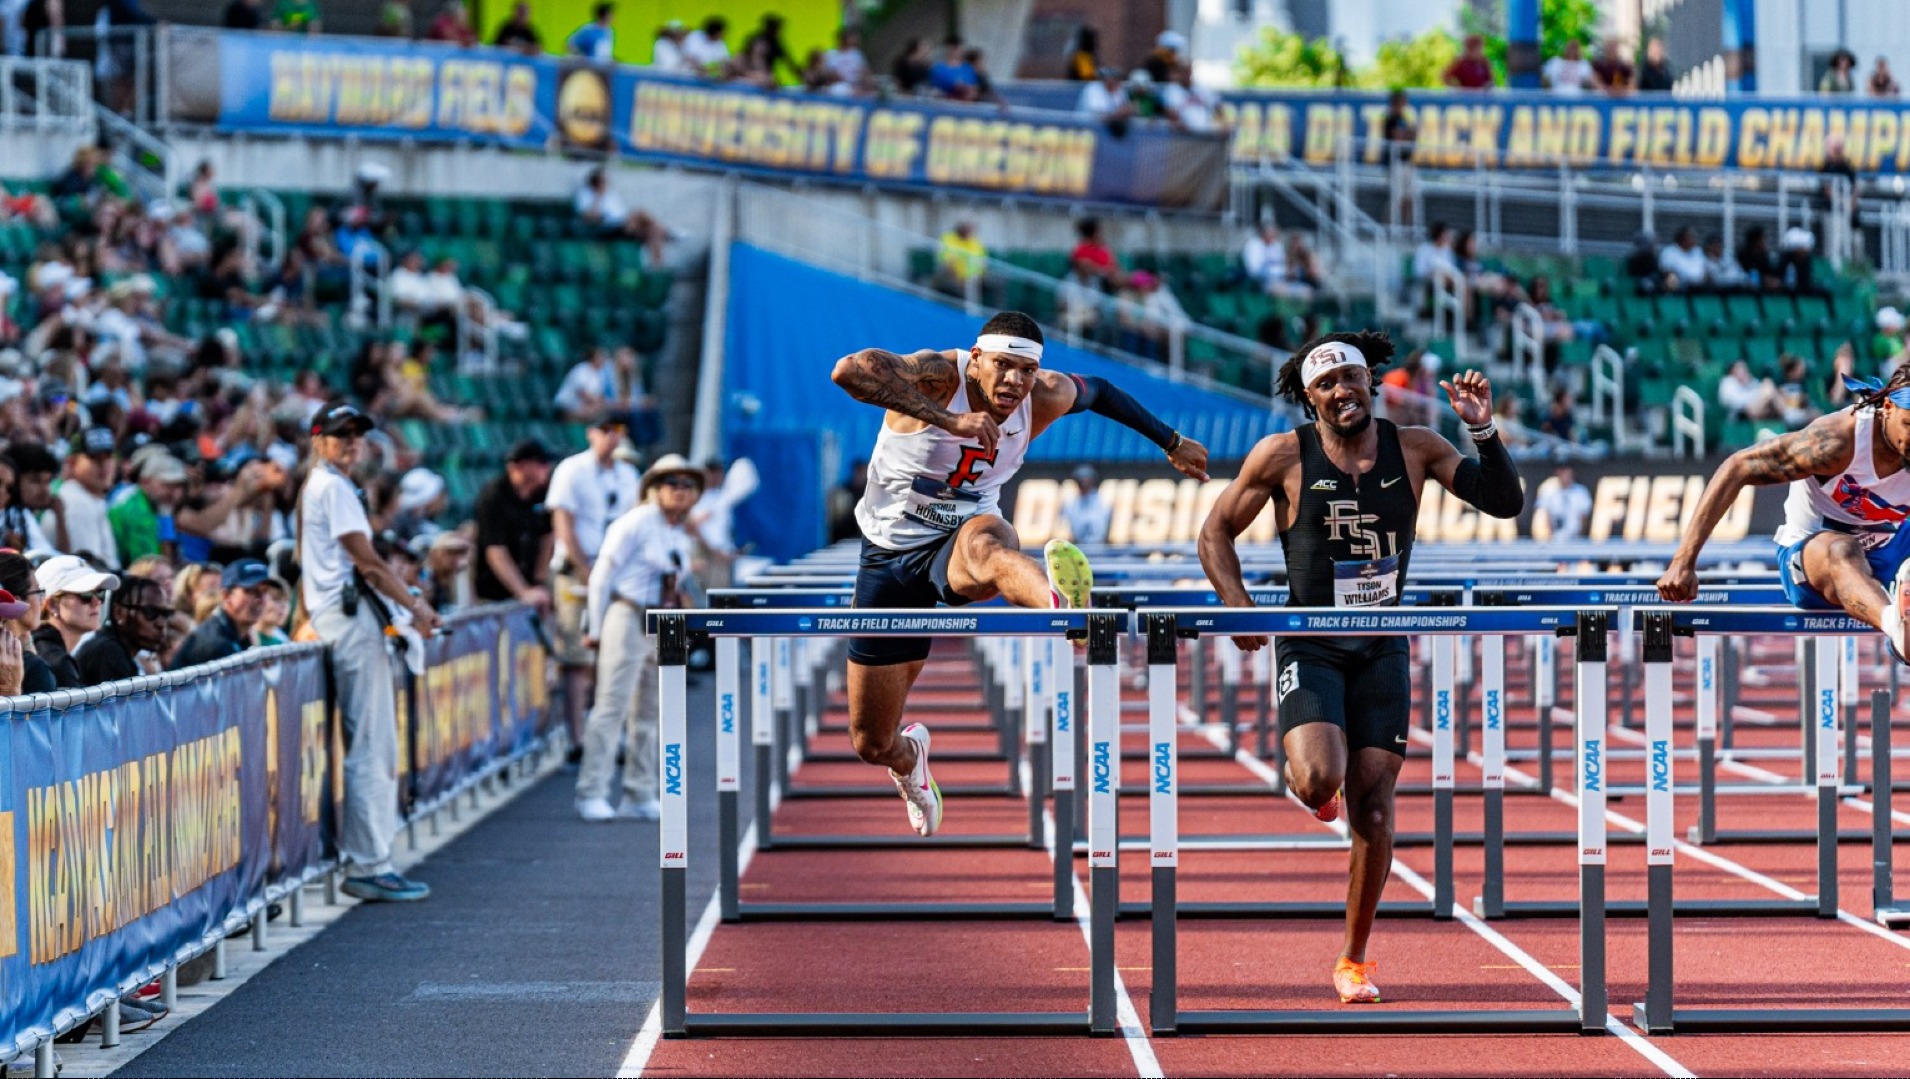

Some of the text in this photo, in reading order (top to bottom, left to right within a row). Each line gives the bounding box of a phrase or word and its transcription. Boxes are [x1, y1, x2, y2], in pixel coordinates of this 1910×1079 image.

[1504, 104, 1601, 169] AND
[1608, 106, 1731, 168] FIELD
[1309, 348, 1347, 365] FSU
[1312, 479, 1339, 490] ACC
[1343, 586, 1390, 605] WILLIAMS
[1356, 580, 1382, 591] TYSON
[817, 618, 851, 630] TRACK
[851, 618, 859, 630] &
[860, 618, 888, 630] FIELD
[890, 618, 978, 630] CHAMPIONSHIPS
[1307, 616, 1340, 628] TRACK
[1341, 616, 1349, 628] &
[1350, 616, 1378, 628] FIELD
[1380, 616, 1467, 628] CHAMPIONSHIPS
[1803, 617, 1837, 629] TRACK
[1837, 618, 1846, 629] &
[721, 693, 734, 734] NCAA
[1057, 691, 1070, 732] NCAA
[1437, 690, 1450, 730] NCAA
[1487, 689, 1500, 730] NCAA
[1821, 688, 1834, 729] NCAA
[665, 743, 682, 796] NCAA
[1094, 741, 1110, 794] NCAA
[1154, 742, 1171, 795] NCAA
[1585, 740, 1600, 792] NCAA
[1652, 740, 1668, 792] NCAA
